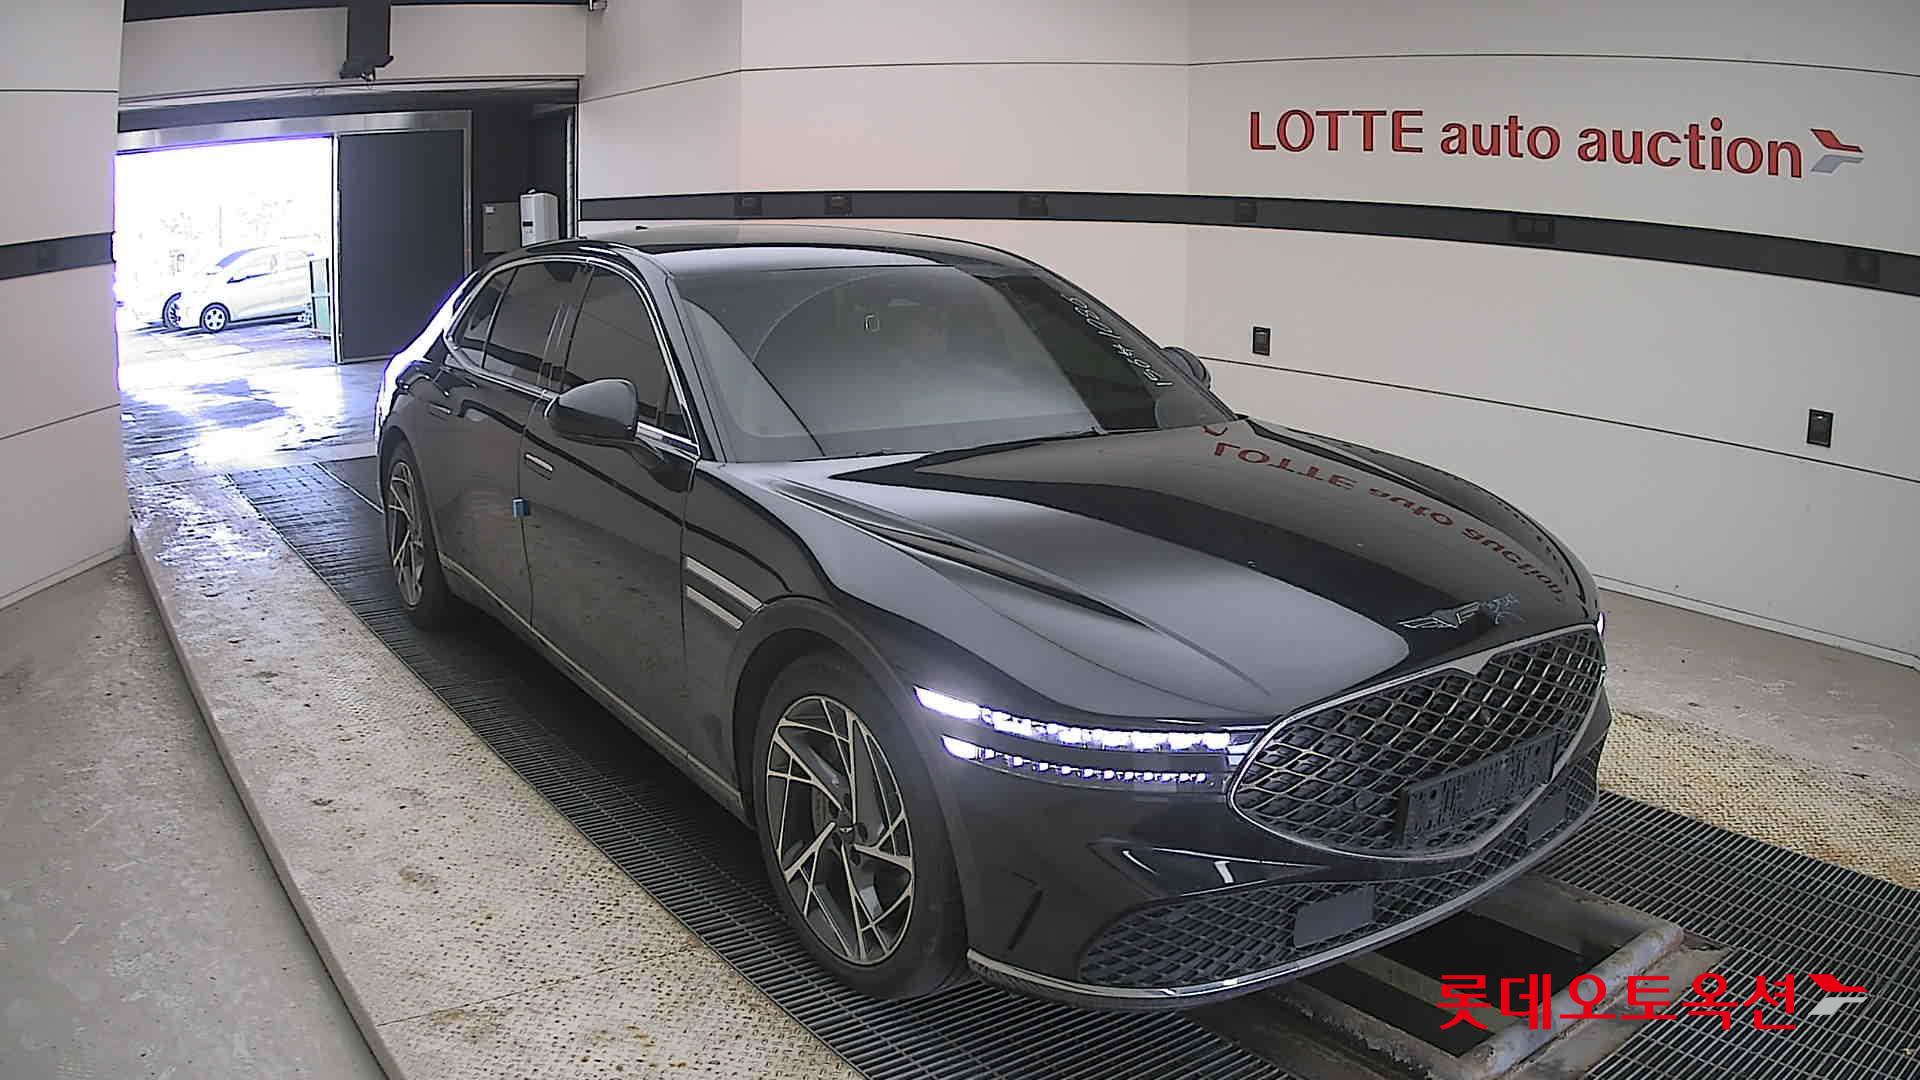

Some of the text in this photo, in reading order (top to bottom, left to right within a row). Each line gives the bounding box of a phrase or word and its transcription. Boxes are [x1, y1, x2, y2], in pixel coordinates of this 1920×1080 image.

[1249, 110, 1804, 178] LOTTE auto auction
